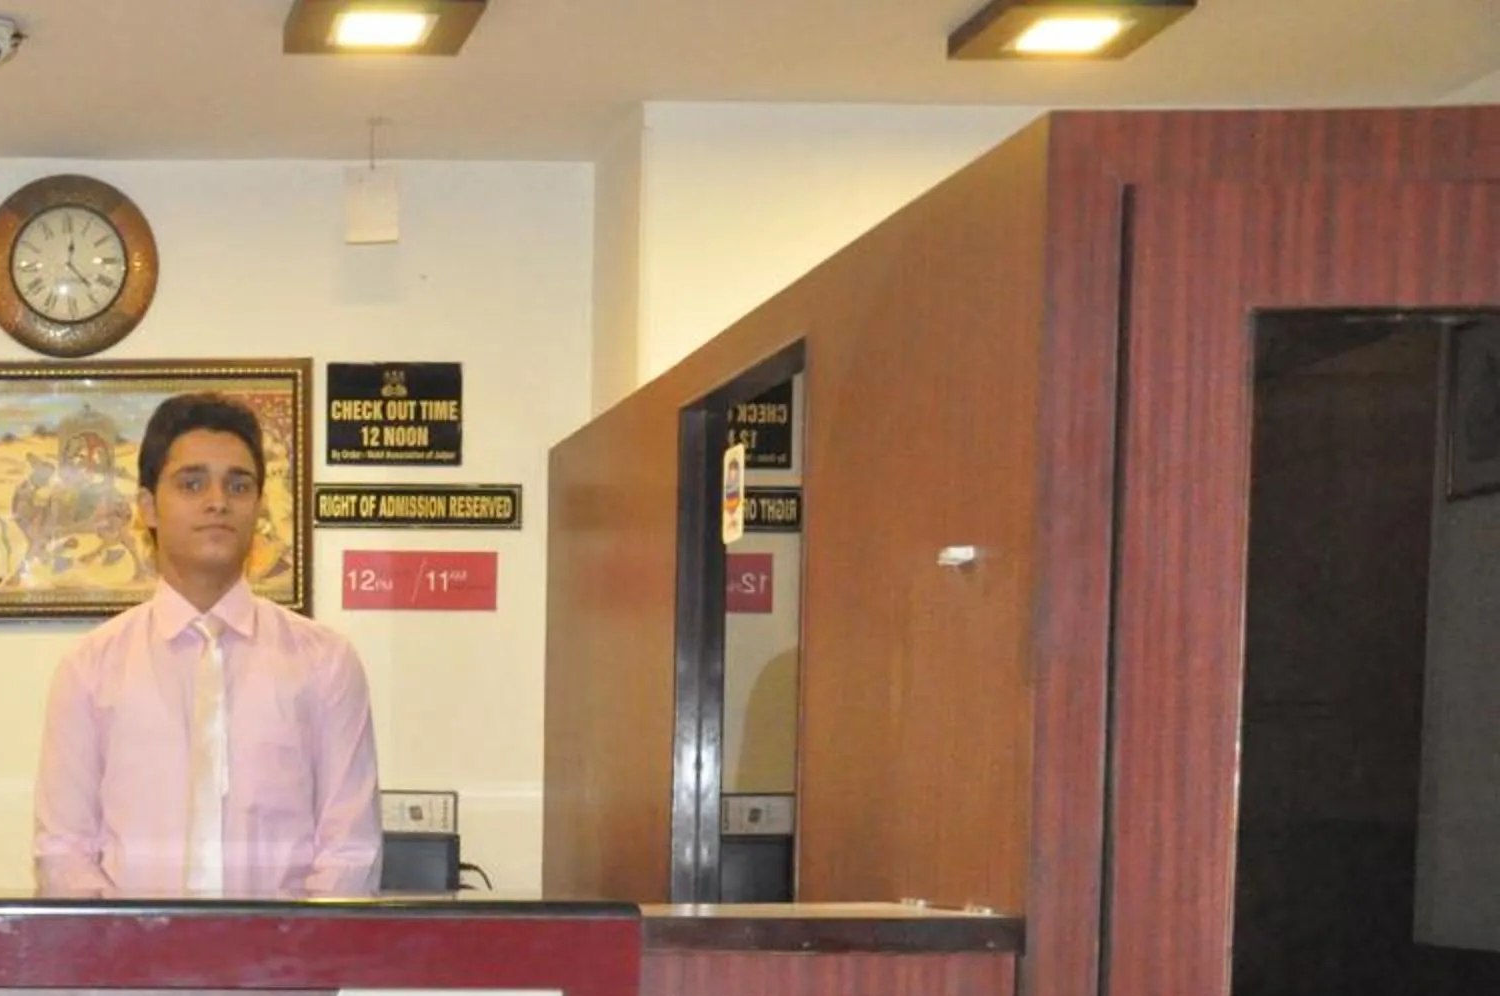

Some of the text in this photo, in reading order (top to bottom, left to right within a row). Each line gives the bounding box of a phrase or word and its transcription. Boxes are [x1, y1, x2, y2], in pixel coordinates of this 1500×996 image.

[331, 400, 459, 420] CHECK OUT TIME
[361, 426, 429, 447] 12 NOON
[319, 495, 513, 519] RIGHT OF ADMISSION RESERVED
